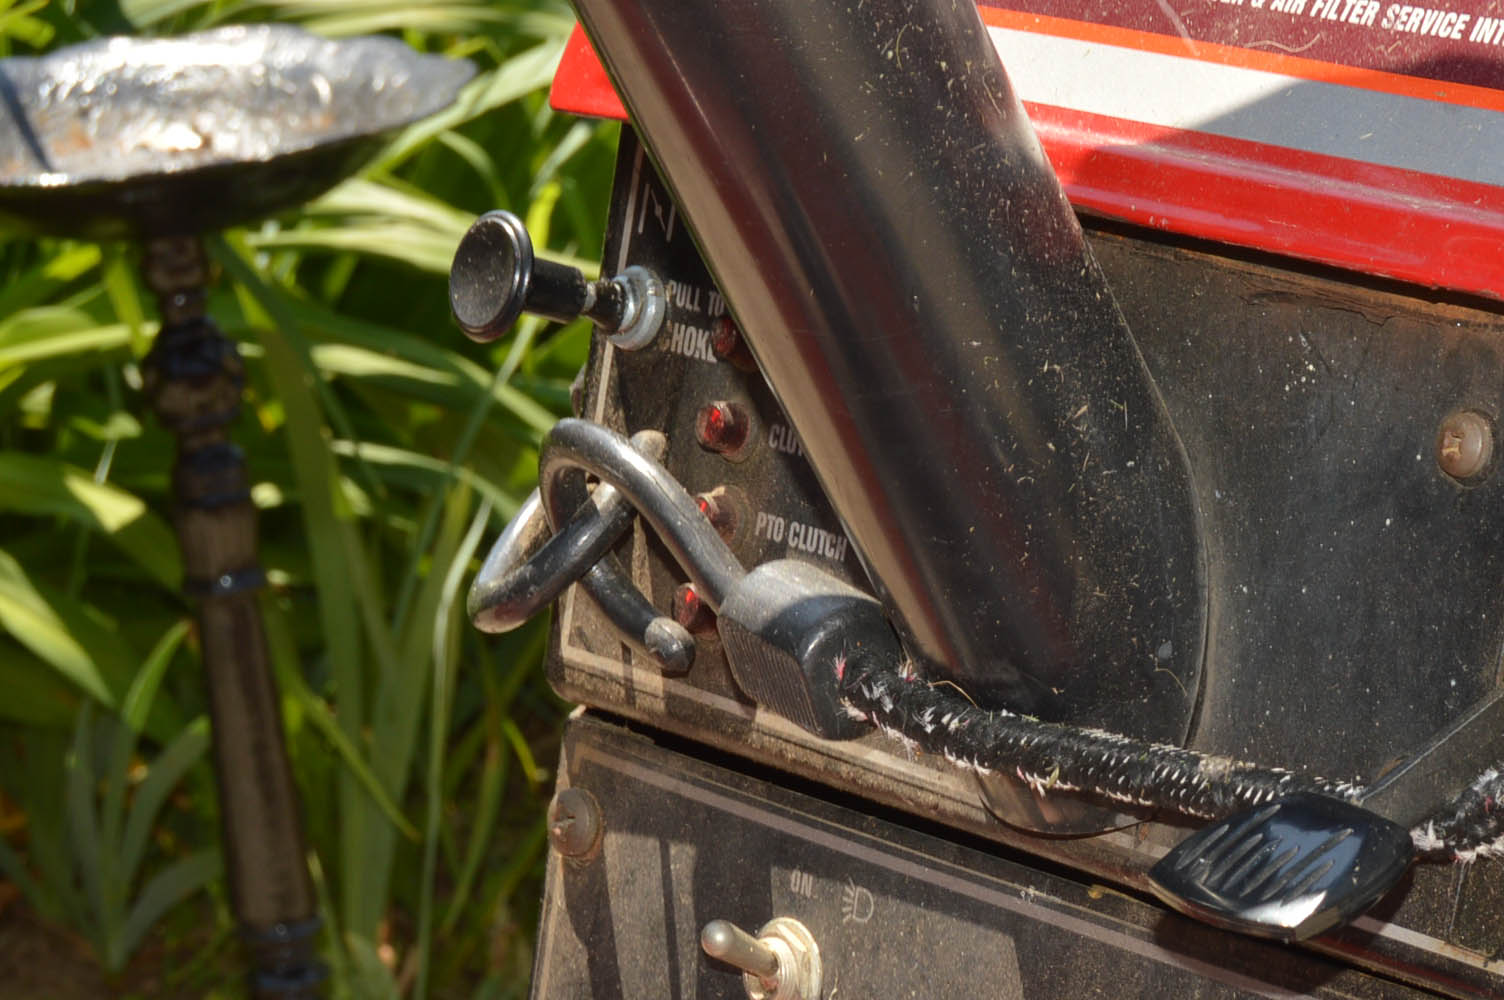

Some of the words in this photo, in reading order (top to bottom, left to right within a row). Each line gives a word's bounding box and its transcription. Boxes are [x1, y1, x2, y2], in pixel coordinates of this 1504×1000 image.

[1310, 0, 1379, 27] FILTER
[1381, 4, 1471, 41] SERVICE
[664, 280, 701, 312] PULL
[754, 511, 785, 543] PTO
[787, 521, 848, 562] CLUTCH
[790, 868, 815, 899] ON
